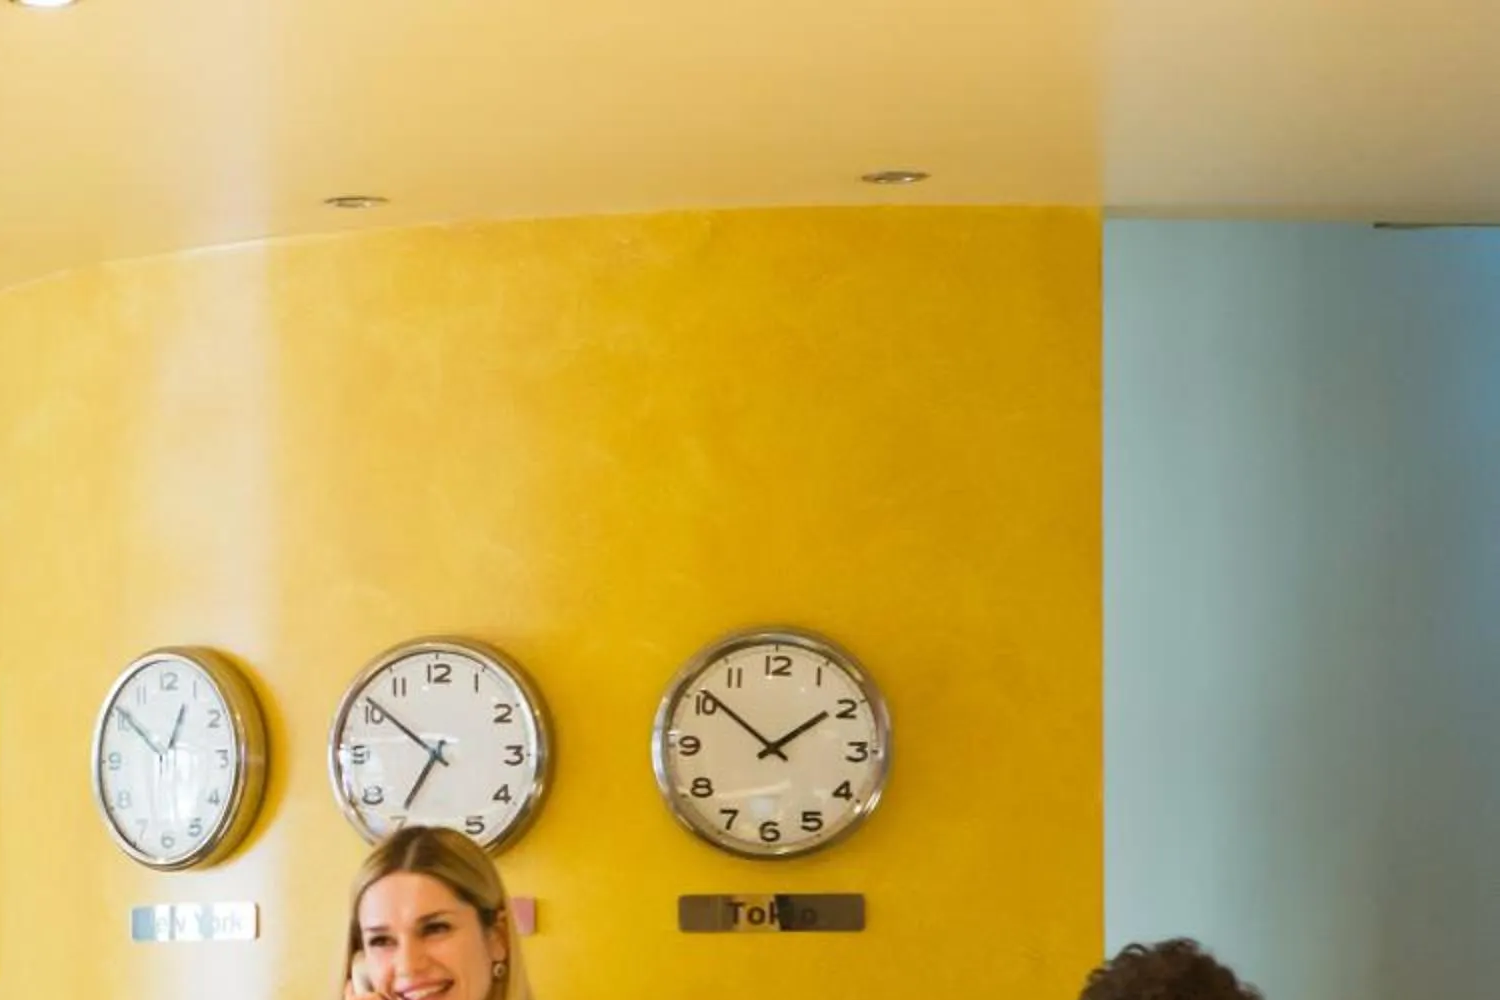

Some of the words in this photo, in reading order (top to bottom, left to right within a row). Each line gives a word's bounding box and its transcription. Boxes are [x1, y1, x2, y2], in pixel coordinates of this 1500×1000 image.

[427, 663, 452, 684] 12
[765, 655, 792, 677] 12
[160, 672, 178, 691] 12
[392, 676, 407, 697] 11
[727, 667, 742, 688] 11
[136, 686, 147, 705] 11
[695, 694, 716, 715] 10
[208, 709, 222, 728] 2
[494, 703, 513, 723] 2
[836, 699, 857, 719] 2
[504, 745, 524, 766] 3
[679, 735, 700, 756] 9
[846, 741, 868, 762] 3
[108, 752, 122, 771] 9
[217, 749, 229, 769] 3
[208, 789, 220, 806] 4
[362, 786, 384, 805] 8
[493, 784, 512, 804] 4
[690, 777, 714, 798] 8
[832, 781, 852, 801] 4
[117, 790, 132, 809] 8
[136, 819, 148, 840] 7
[188, 818, 203, 837] 5
[465, 815, 484, 835] 5
[720, 809, 739, 830] 7
[801, 811, 823, 832] 5
[161, 830, 175, 849] 6
[759, 821, 780, 842] 6
[140, 909, 187, 934] ew
[727, 901, 818, 926] Toko
